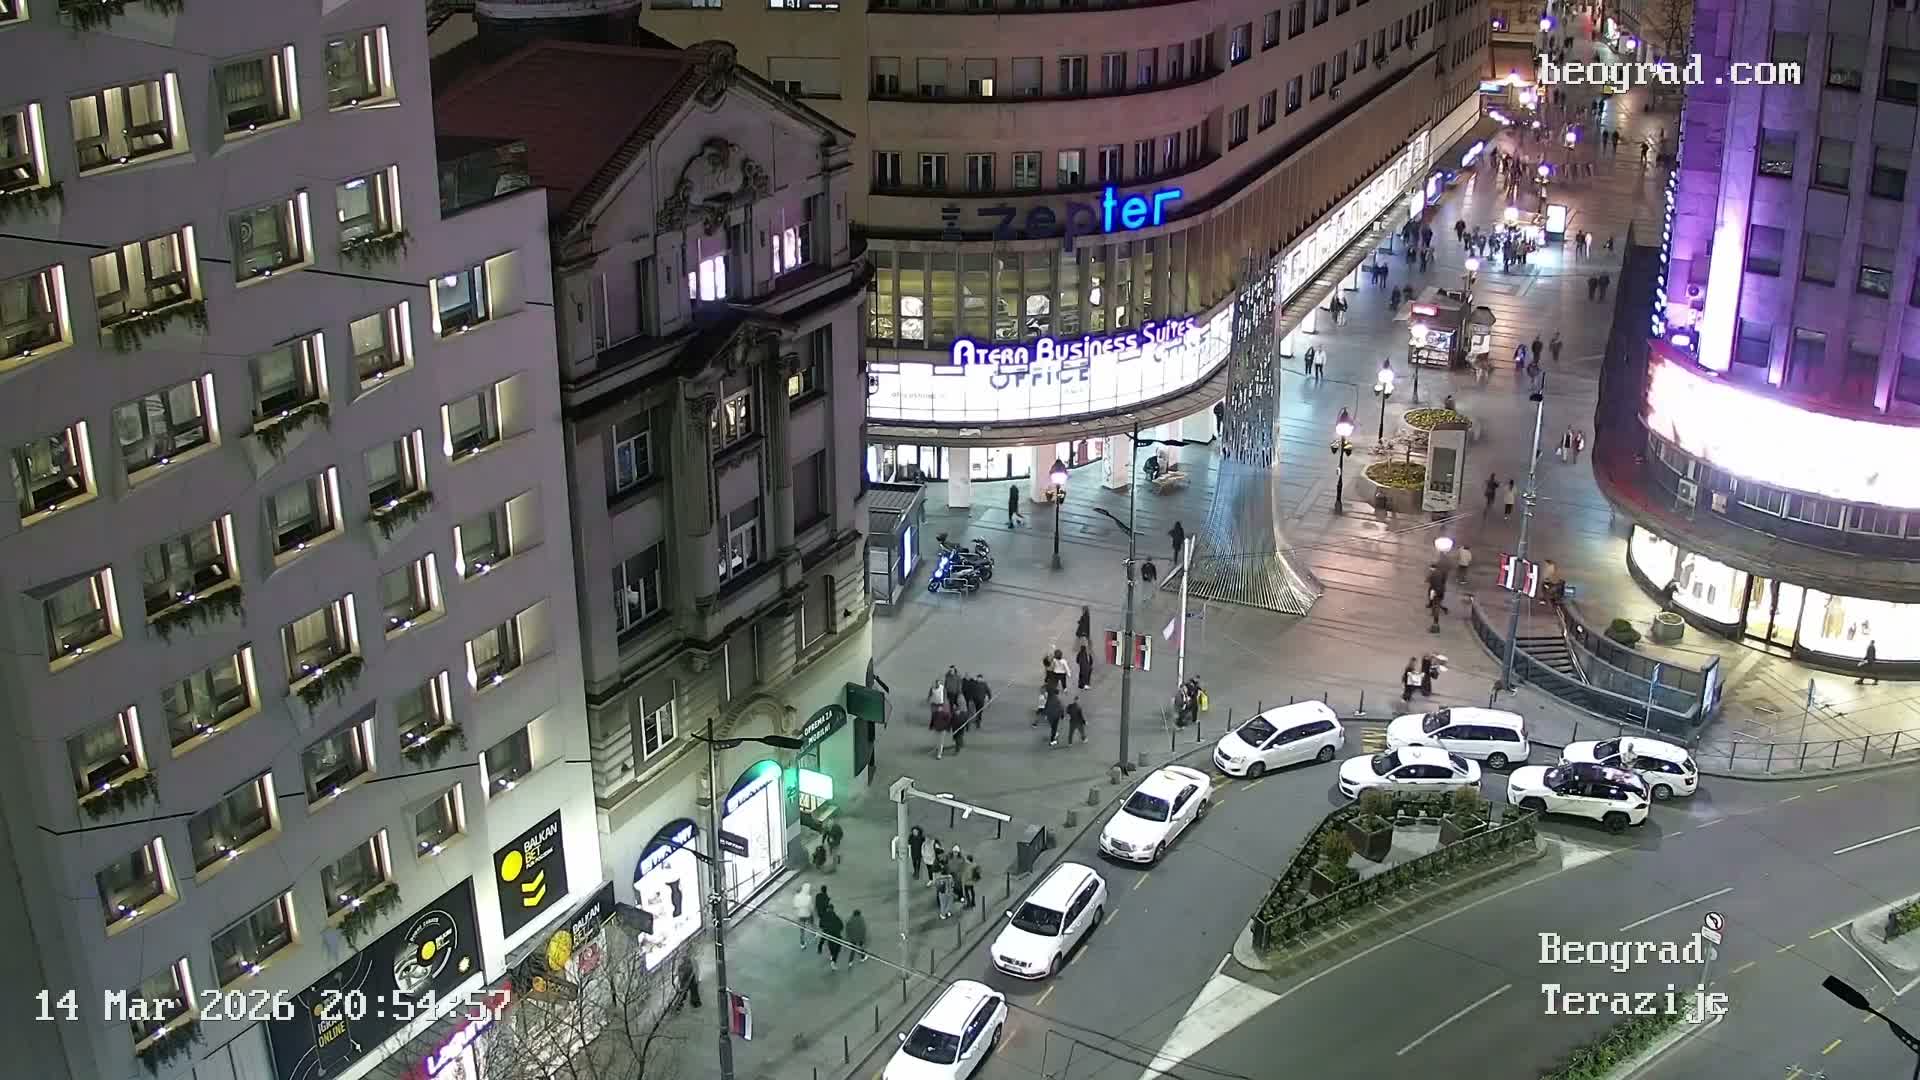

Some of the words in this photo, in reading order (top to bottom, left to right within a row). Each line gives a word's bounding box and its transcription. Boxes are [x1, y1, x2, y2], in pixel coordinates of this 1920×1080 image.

[977, 186, 1182, 253] zepter
[523, 821, 558, 853] BALKAN
[525, 844, 541, 865] BET
[572, 902, 600, 934] BALKAN
[318, 1020, 346, 1048] ONLINE
